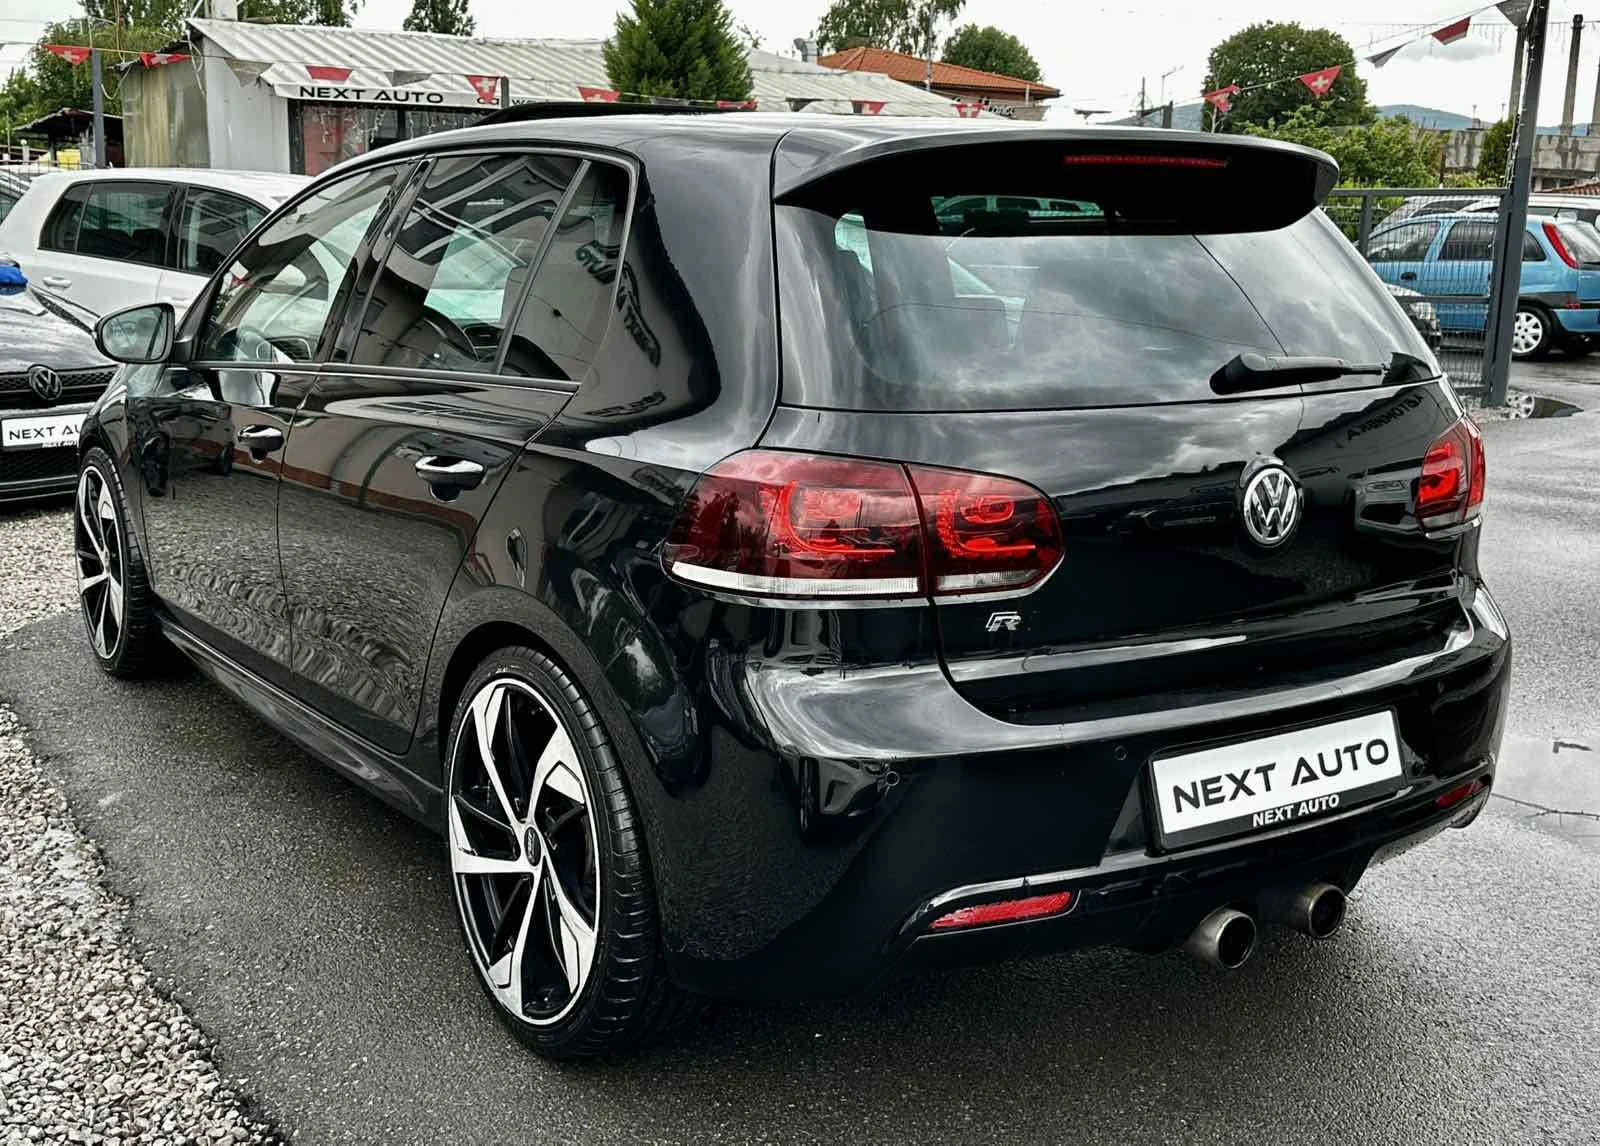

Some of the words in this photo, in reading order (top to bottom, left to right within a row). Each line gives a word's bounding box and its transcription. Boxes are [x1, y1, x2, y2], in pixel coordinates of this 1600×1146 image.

[300, 86, 366, 100] NEXT
[374, 89, 444, 104] AUTO
[9, 425, 56, 441] NEXT
[1247, 469, 1297, 543] VW
[1172, 762, 1277, 814] NEXT
[1291, 738, 1390, 787] AUTO
[1252, 804, 1294, 828] NEXT
[1298, 794, 1340, 817] AUTO
